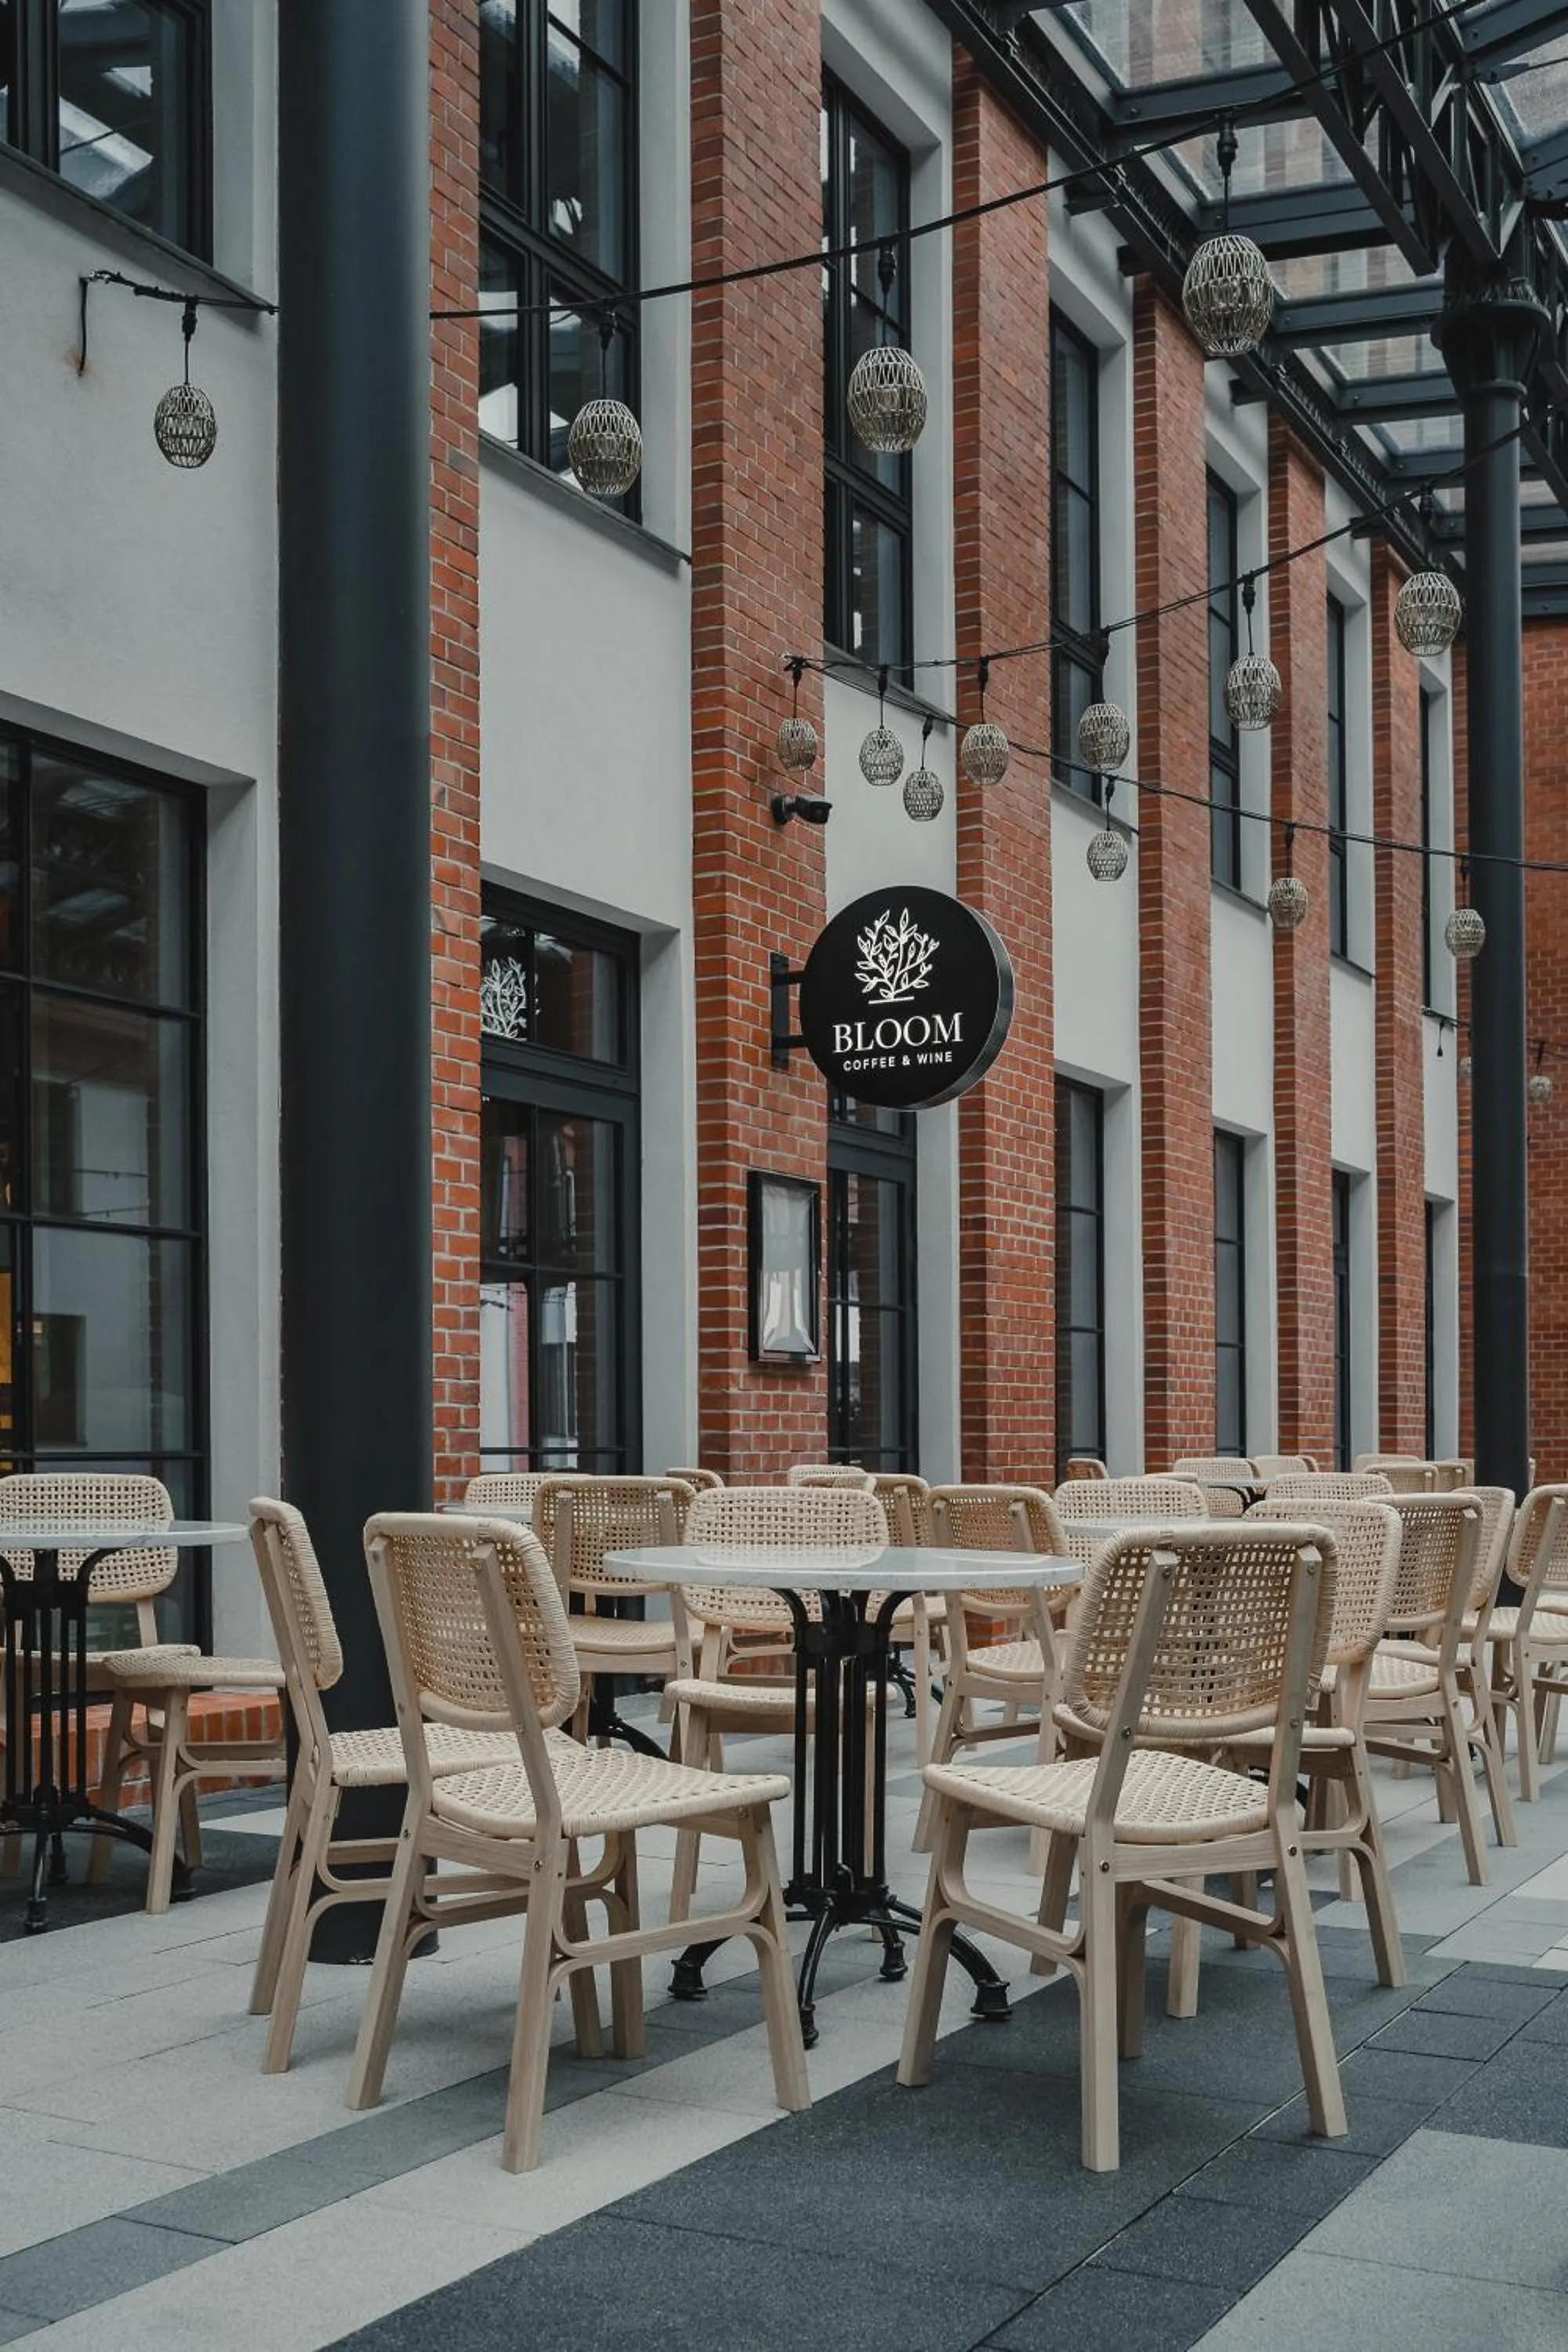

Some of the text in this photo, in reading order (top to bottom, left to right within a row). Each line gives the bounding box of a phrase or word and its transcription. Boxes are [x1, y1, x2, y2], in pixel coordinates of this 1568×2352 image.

[832, 1012, 964, 1054] BLOOM
[843, 1051, 953, 1072] COFFEE & WINE
